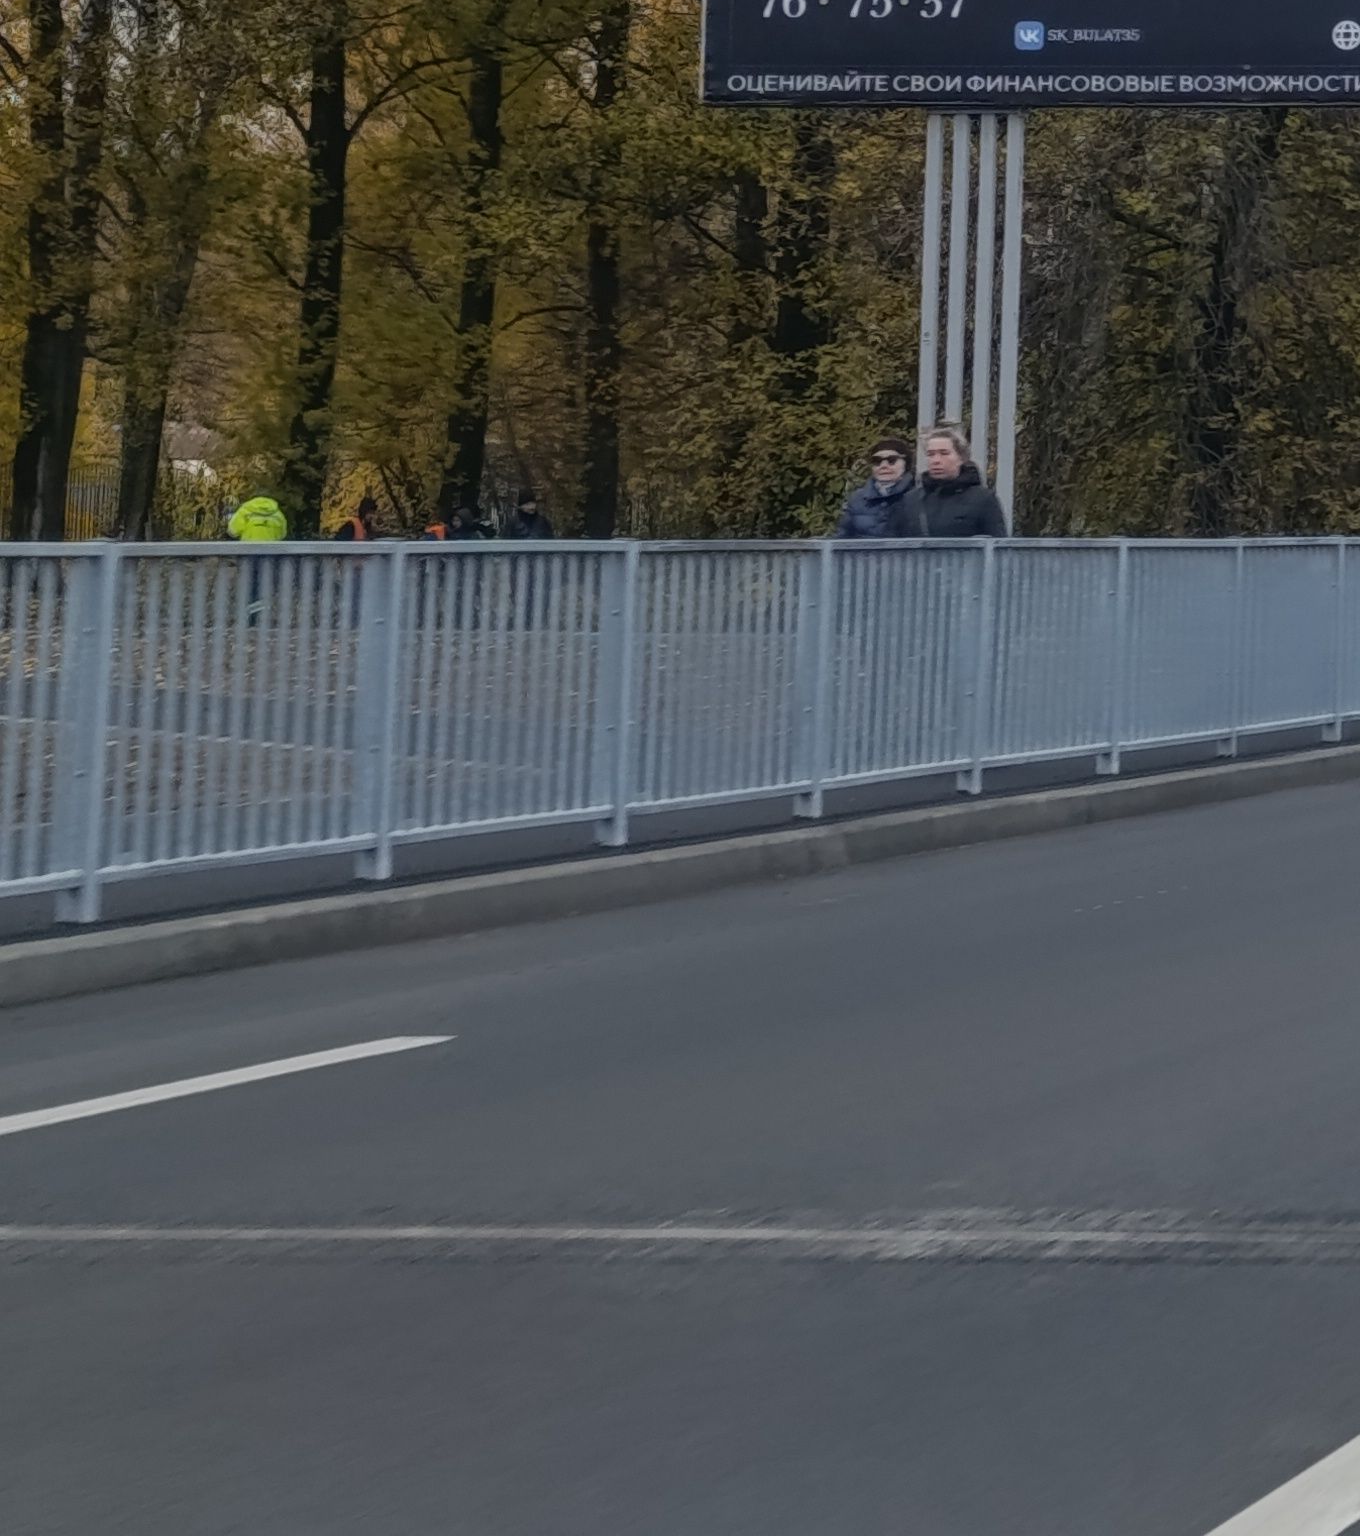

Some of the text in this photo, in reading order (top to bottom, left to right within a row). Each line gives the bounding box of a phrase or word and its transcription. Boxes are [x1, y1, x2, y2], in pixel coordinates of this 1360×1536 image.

[727, 69, 890, 94] ОЦЕНИВАЙТЕ
[892, 74, 962, 92] СВОИ
[966, 74, 1175, 92] ФИНАНСОВОВЫЕ
